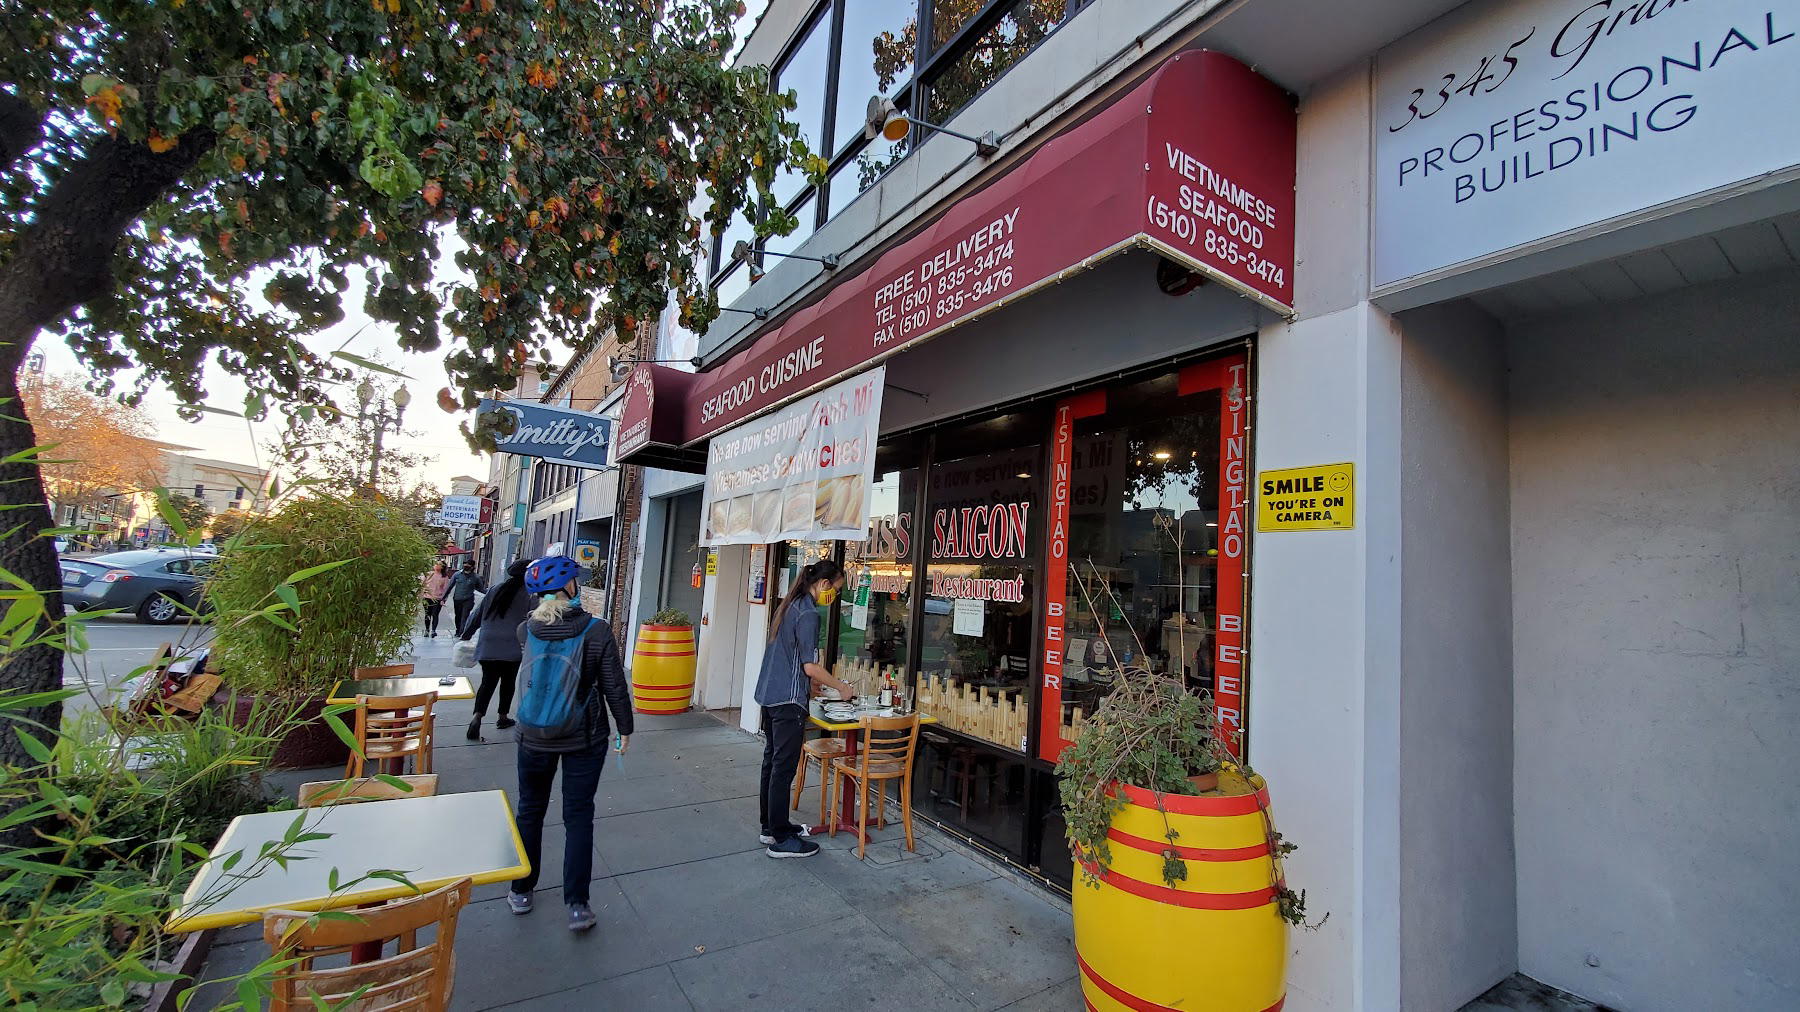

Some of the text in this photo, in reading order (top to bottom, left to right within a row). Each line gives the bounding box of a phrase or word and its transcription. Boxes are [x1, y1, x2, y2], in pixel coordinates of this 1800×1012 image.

[1390, 0, 1693, 133] 3345 Gra
[1399, 12, 1796, 187] PROFESSIONAL
[1165, 141, 1276, 229] VIETNAMESE
[1455, 94, 1698, 204] BUILDING
[874, 206, 1020, 309] FREE DELIVERY
[1147, 195, 1285, 289] (510) 835-3474
[1178, 184, 1263, 249] SEAFOOD
[873, 265, 1013, 348] FAX (510) 835-3476
[875, 239, 1014, 327] TEL (510) 835-3474
[701, 335, 825, 424] SEAFOOD CUISINE
[494, 405, 609, 458] Smitty's
[725, 440, 740, 460] are
[741, 432, 762, 455] now
[444, 512, 478, 520] HOSPITAL
[1263, 476, 1324, 496] SMILE
[1268, 496, 1344, 511] YOU'RE ON
[1276, 510, 1332, 523] CAMERA
[932, 501, 1030, 559] SAIGON
[1044, 406, 1068, 689] TSINGTAO BEER
[1217, 364, 1244, 728] TSINGTAO BEER
[845, 566, 908, 595] Viamese
[931, 569, 1024, 603] Restaurant
